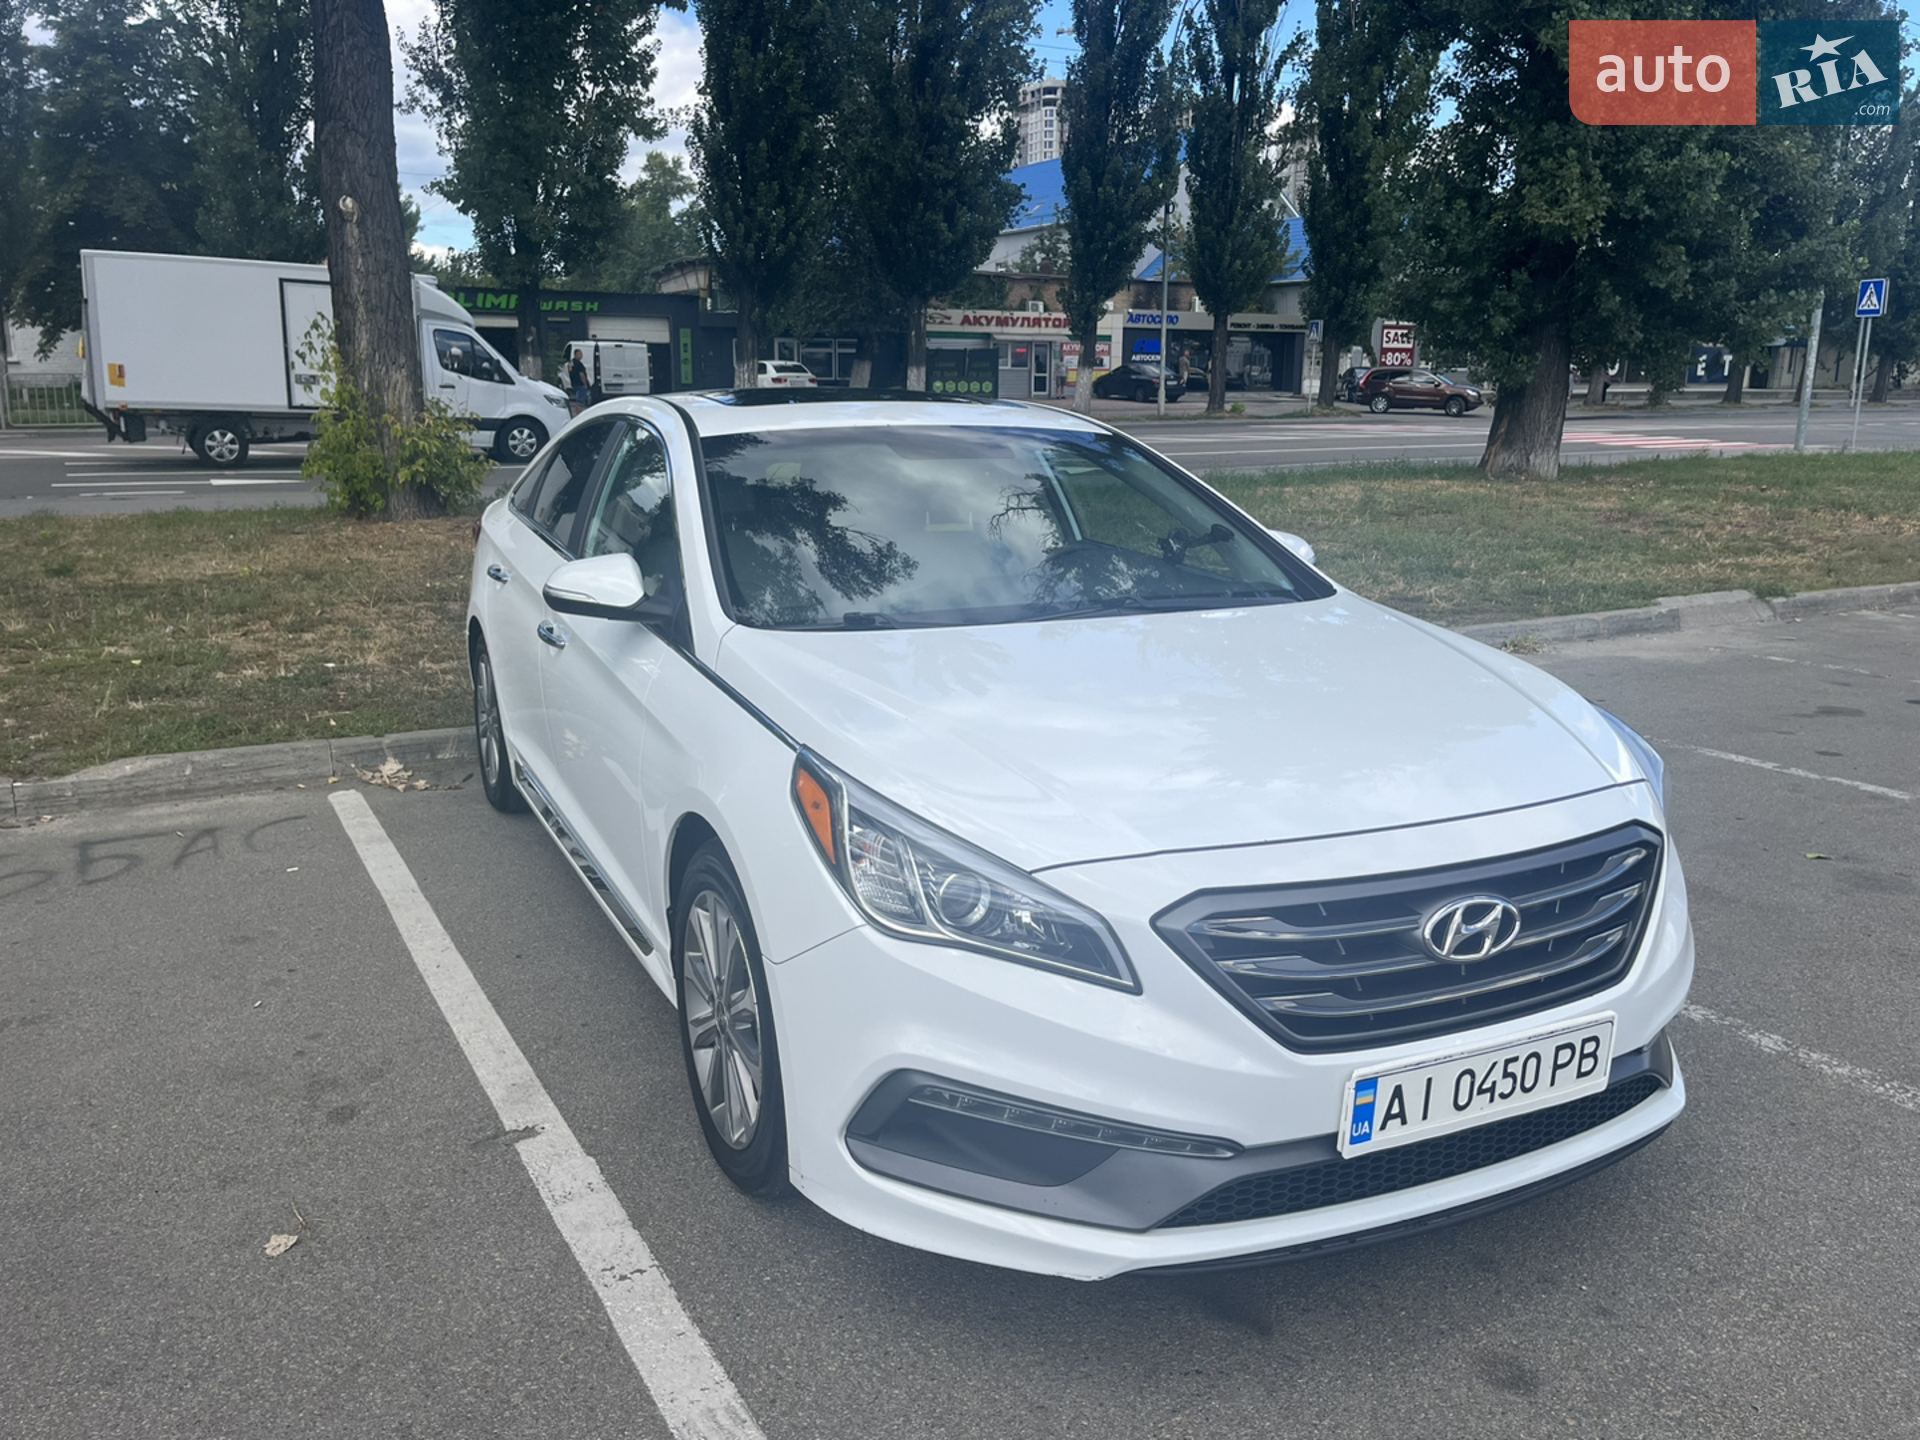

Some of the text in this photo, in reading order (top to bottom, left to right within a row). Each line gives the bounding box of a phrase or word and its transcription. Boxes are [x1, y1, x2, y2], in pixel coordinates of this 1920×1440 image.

[540, 300, 600, 312] WASH
[1452, 1051, 1542, 1111] 0450
[1549, 1035, 1600, 1087] PB
[1352, 1120, 1370, 1137] UA
